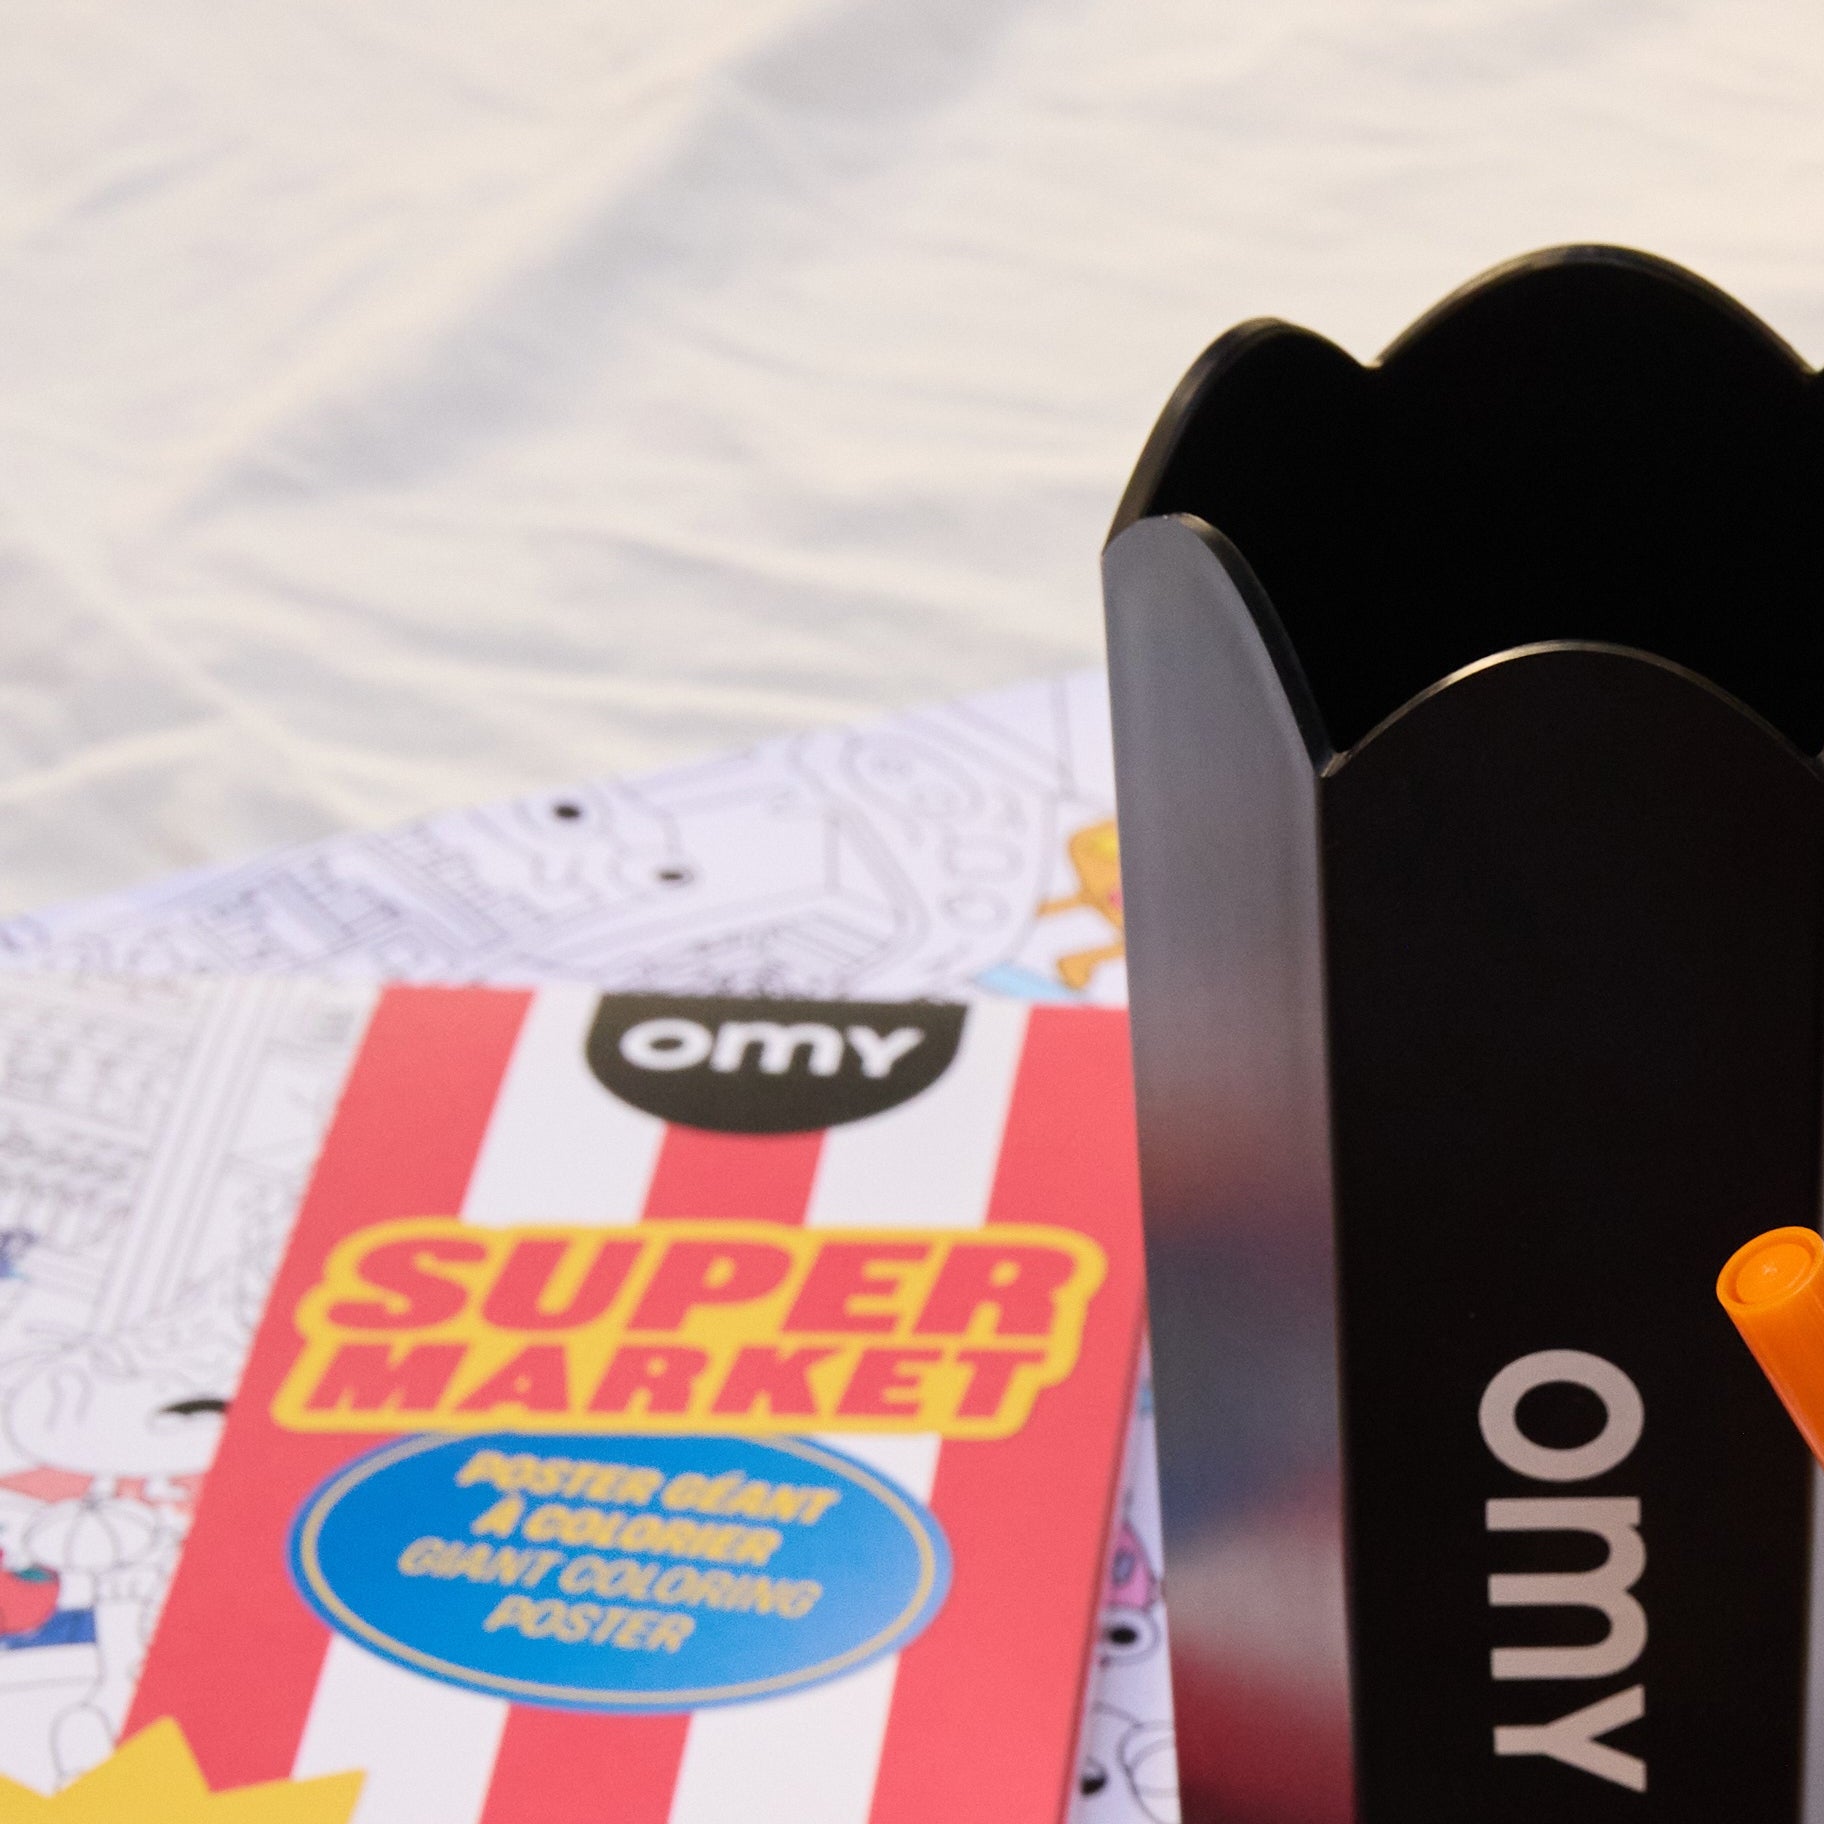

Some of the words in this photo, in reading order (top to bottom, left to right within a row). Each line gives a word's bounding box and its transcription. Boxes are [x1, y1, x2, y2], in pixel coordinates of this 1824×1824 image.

[619, 1018, 925, 1078] omy
[322, 1235, 1077, 1335] SUPER
[300, 1341, 1047, 1418] MARKET
[455, 1449, 664, 1506] POSTER
[660, 1470, 841, 1525] GÉANT
[523, 1504, 783, 1567] COLORIER
[1478, 1349, 1648, 1793] omy
[398, 1536, 564, 1587] GIANT
[558, 1555, 823, 1619] COLORING
[483, 1594, 696, 1654] POSTER
